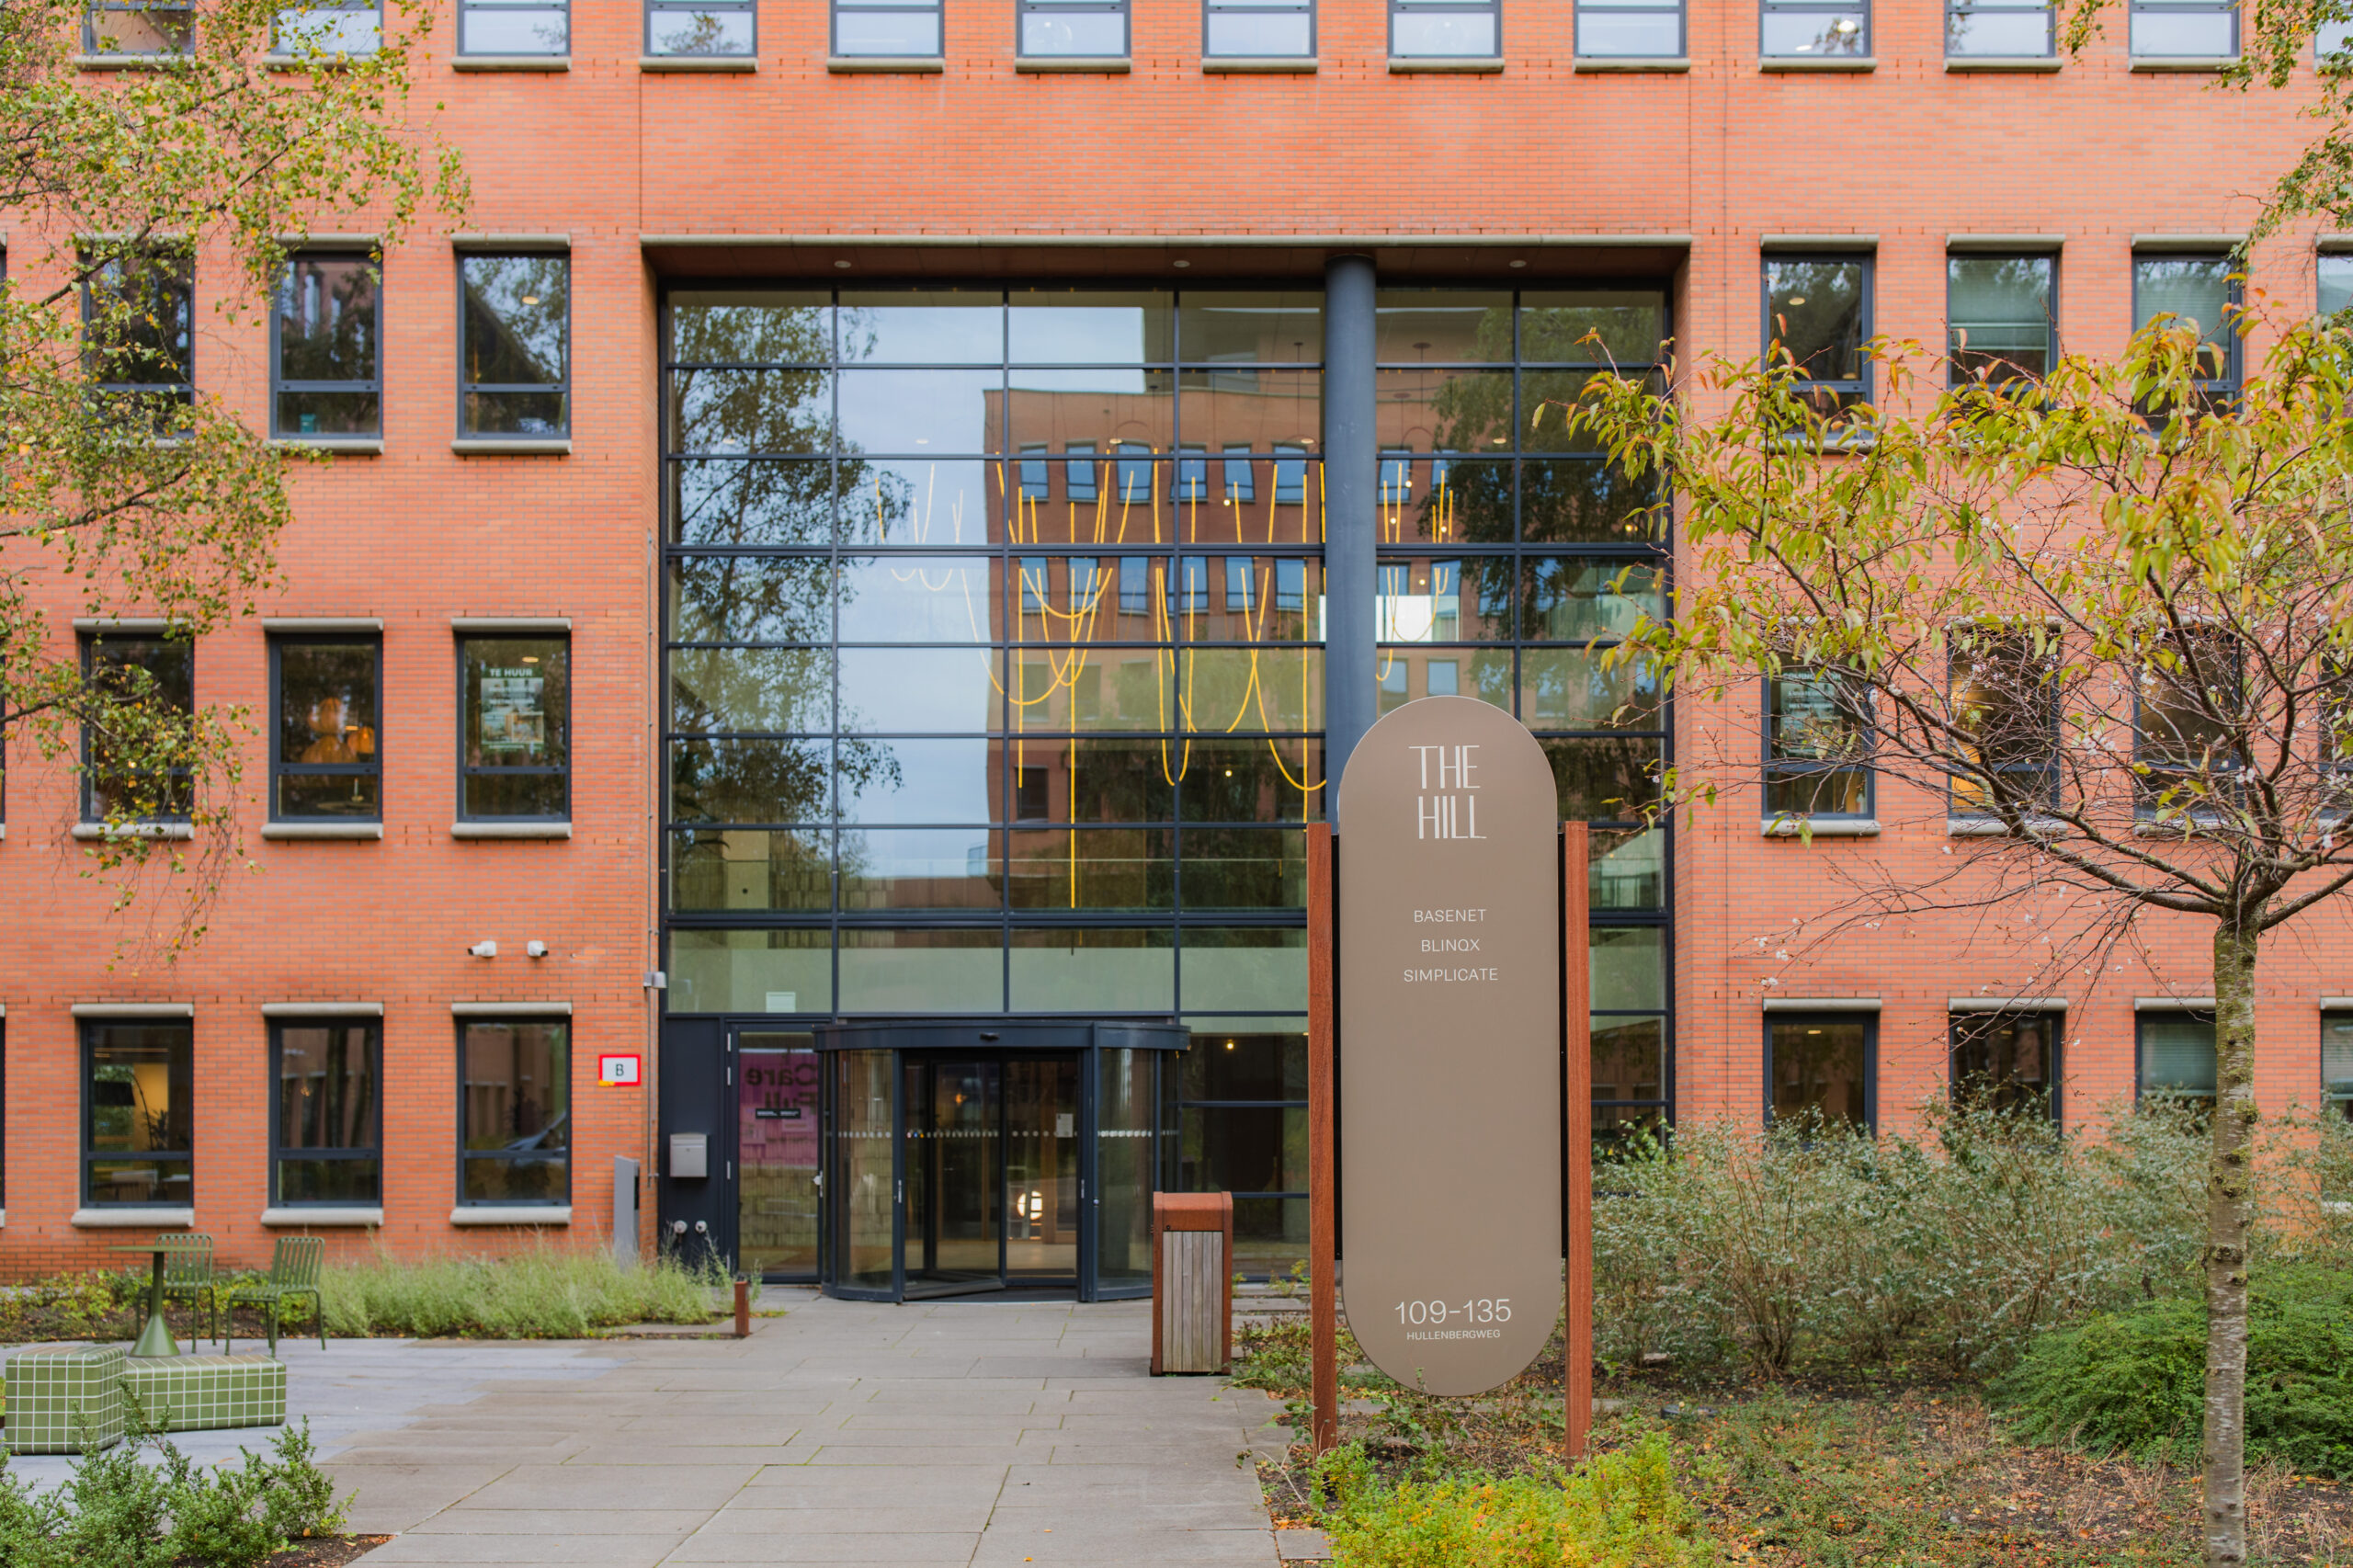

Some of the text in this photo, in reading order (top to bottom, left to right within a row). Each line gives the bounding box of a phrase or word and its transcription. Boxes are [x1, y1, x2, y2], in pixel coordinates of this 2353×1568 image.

[490, 668, 533, 677] TE HUUR
[1408, 744, 1481, 789] THE
[1418, 795, 1487, 839] HILL
[1414, 909, 1486, 923] BASENET
[1421, 938, 1480, 952] BLINQX
[1404, 968, 1498, 983] SIMPLICATE
[616, 1063, 624, 1076] B
[1394, 1298, 1512, 1324] 109-135
[1406, 1329, 1501, 1341] HULLENBERGWEG
